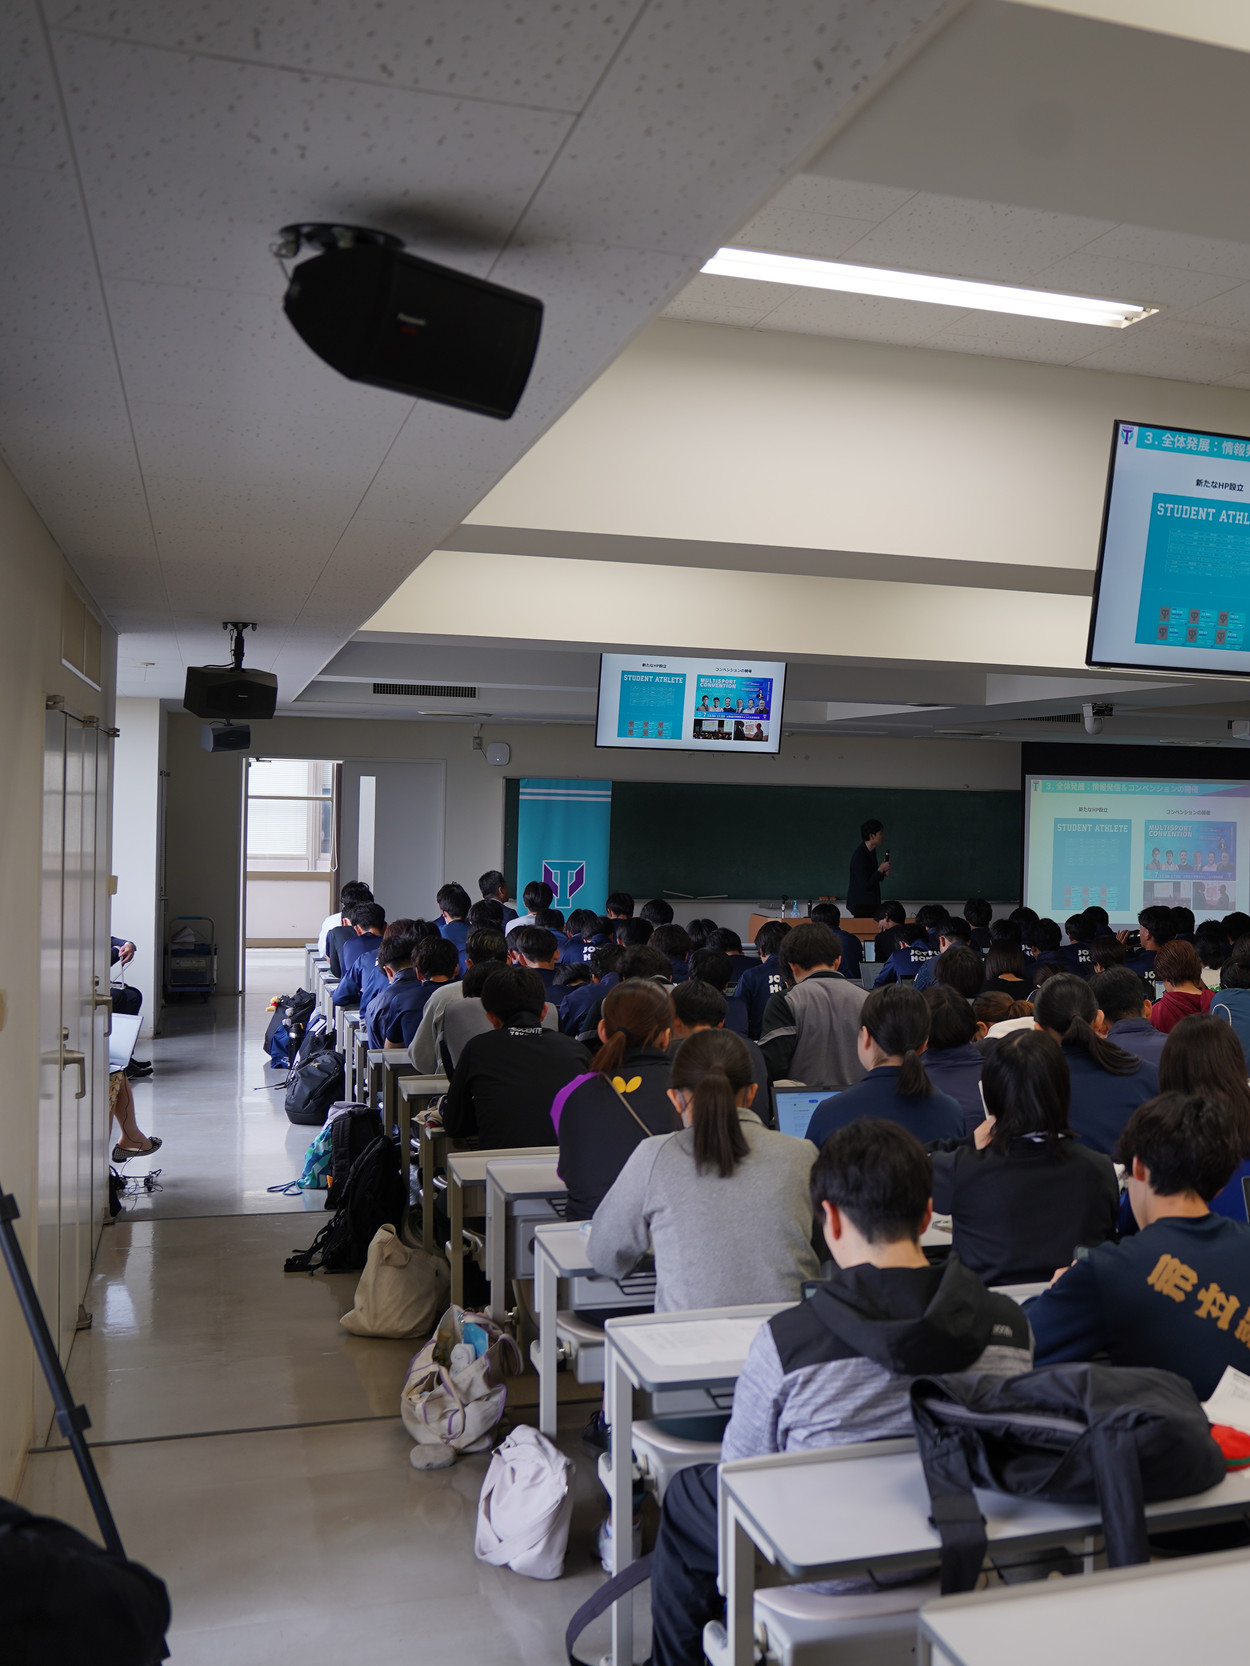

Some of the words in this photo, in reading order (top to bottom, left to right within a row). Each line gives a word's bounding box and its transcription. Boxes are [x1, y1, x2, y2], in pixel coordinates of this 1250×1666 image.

[1195, 478, 1245, 492] 新たなHP設立
[1157, 503, 1216, 521] STUDENT
[623, 674, 654, 682] STUDENT
[655, 676, 684, 684] ATHLETE
[1057, 823, 1093, 832] STUDENT
[1095, 824, 1129, 833] ATHLETE
[1148, 830, 1193, 838] CONVENTION
